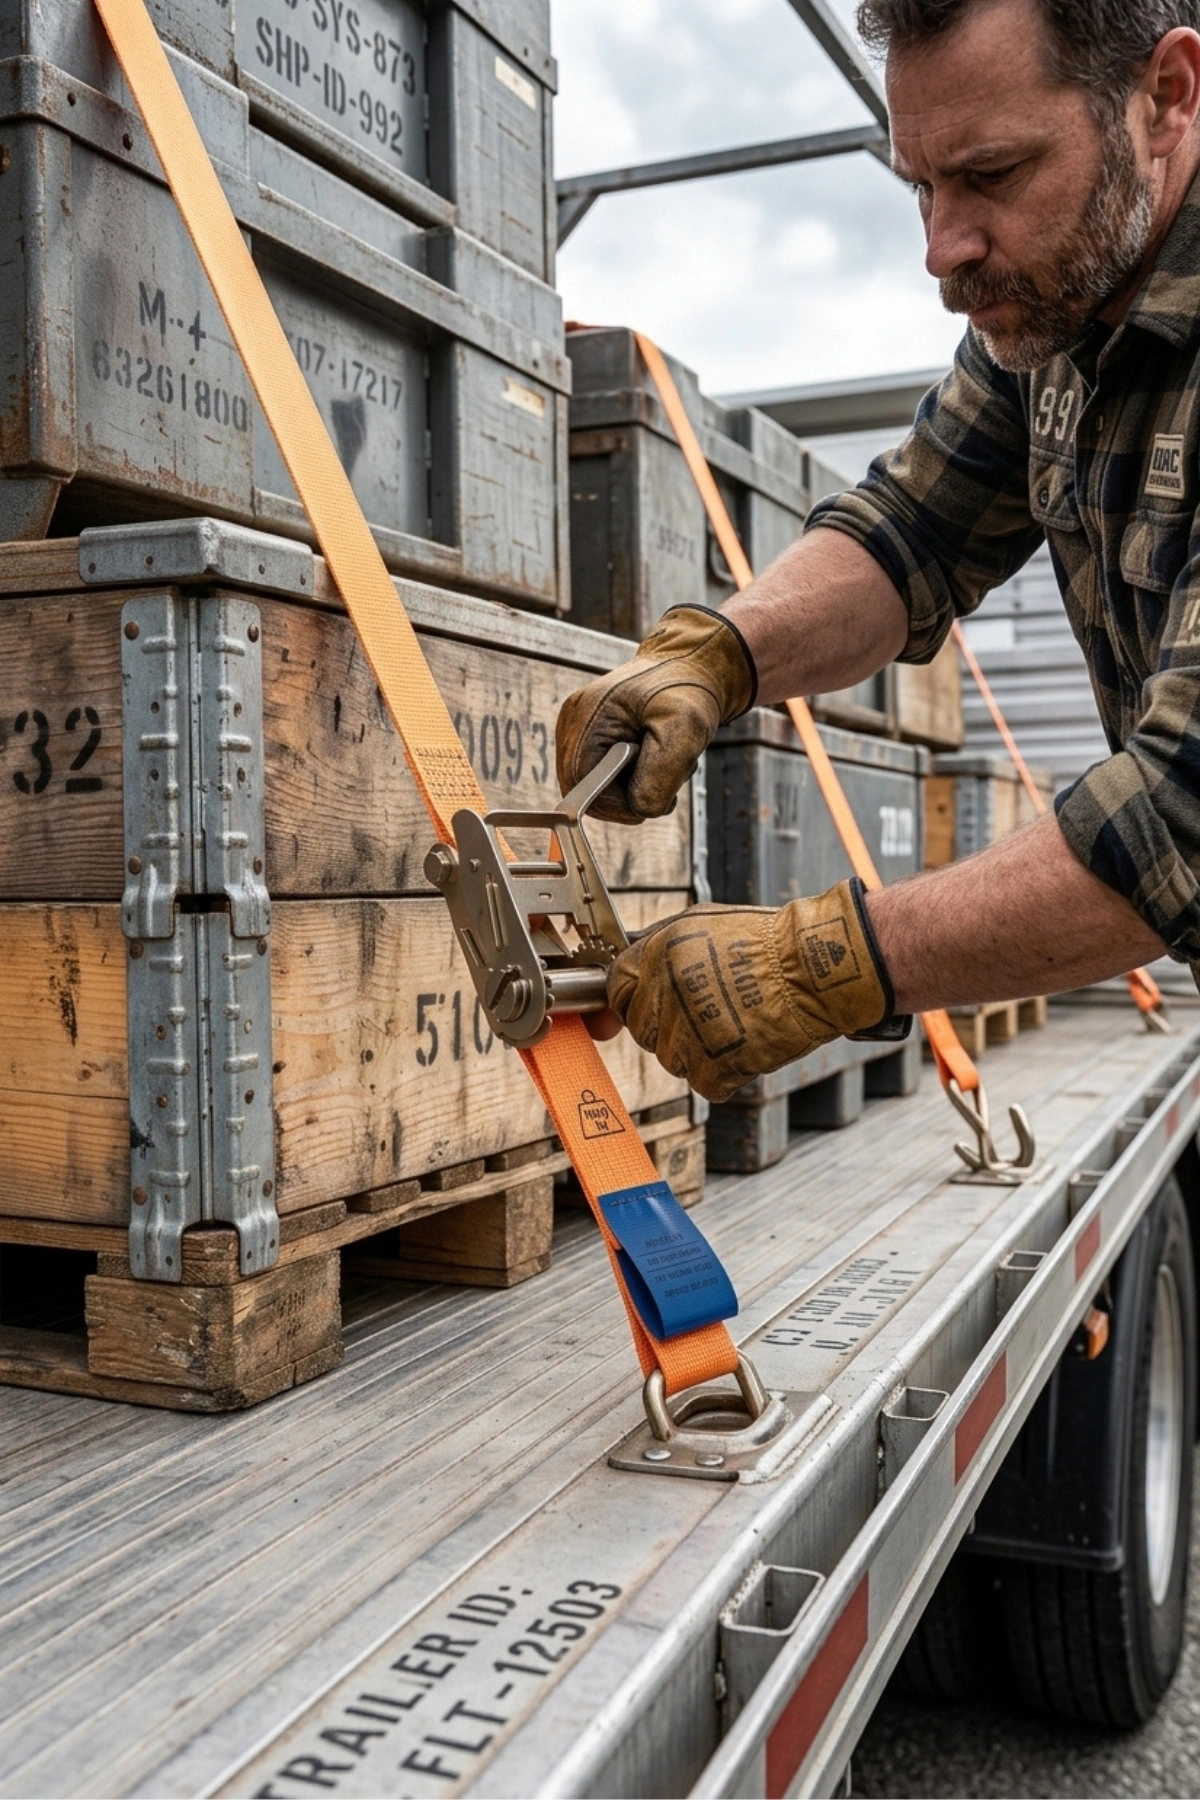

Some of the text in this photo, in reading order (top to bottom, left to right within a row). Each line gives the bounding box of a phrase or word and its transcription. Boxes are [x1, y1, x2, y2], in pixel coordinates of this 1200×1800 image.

[256, 16, 403, 156] SHP-ID-992
[285, 0, 415, 96] SYS-873
[1035, 386, 1076, 442] 99
[13, 706, 103, 794] 32
[416, 990, 512, 1067] 510
[447, 1585, 533, 1627] ID:
